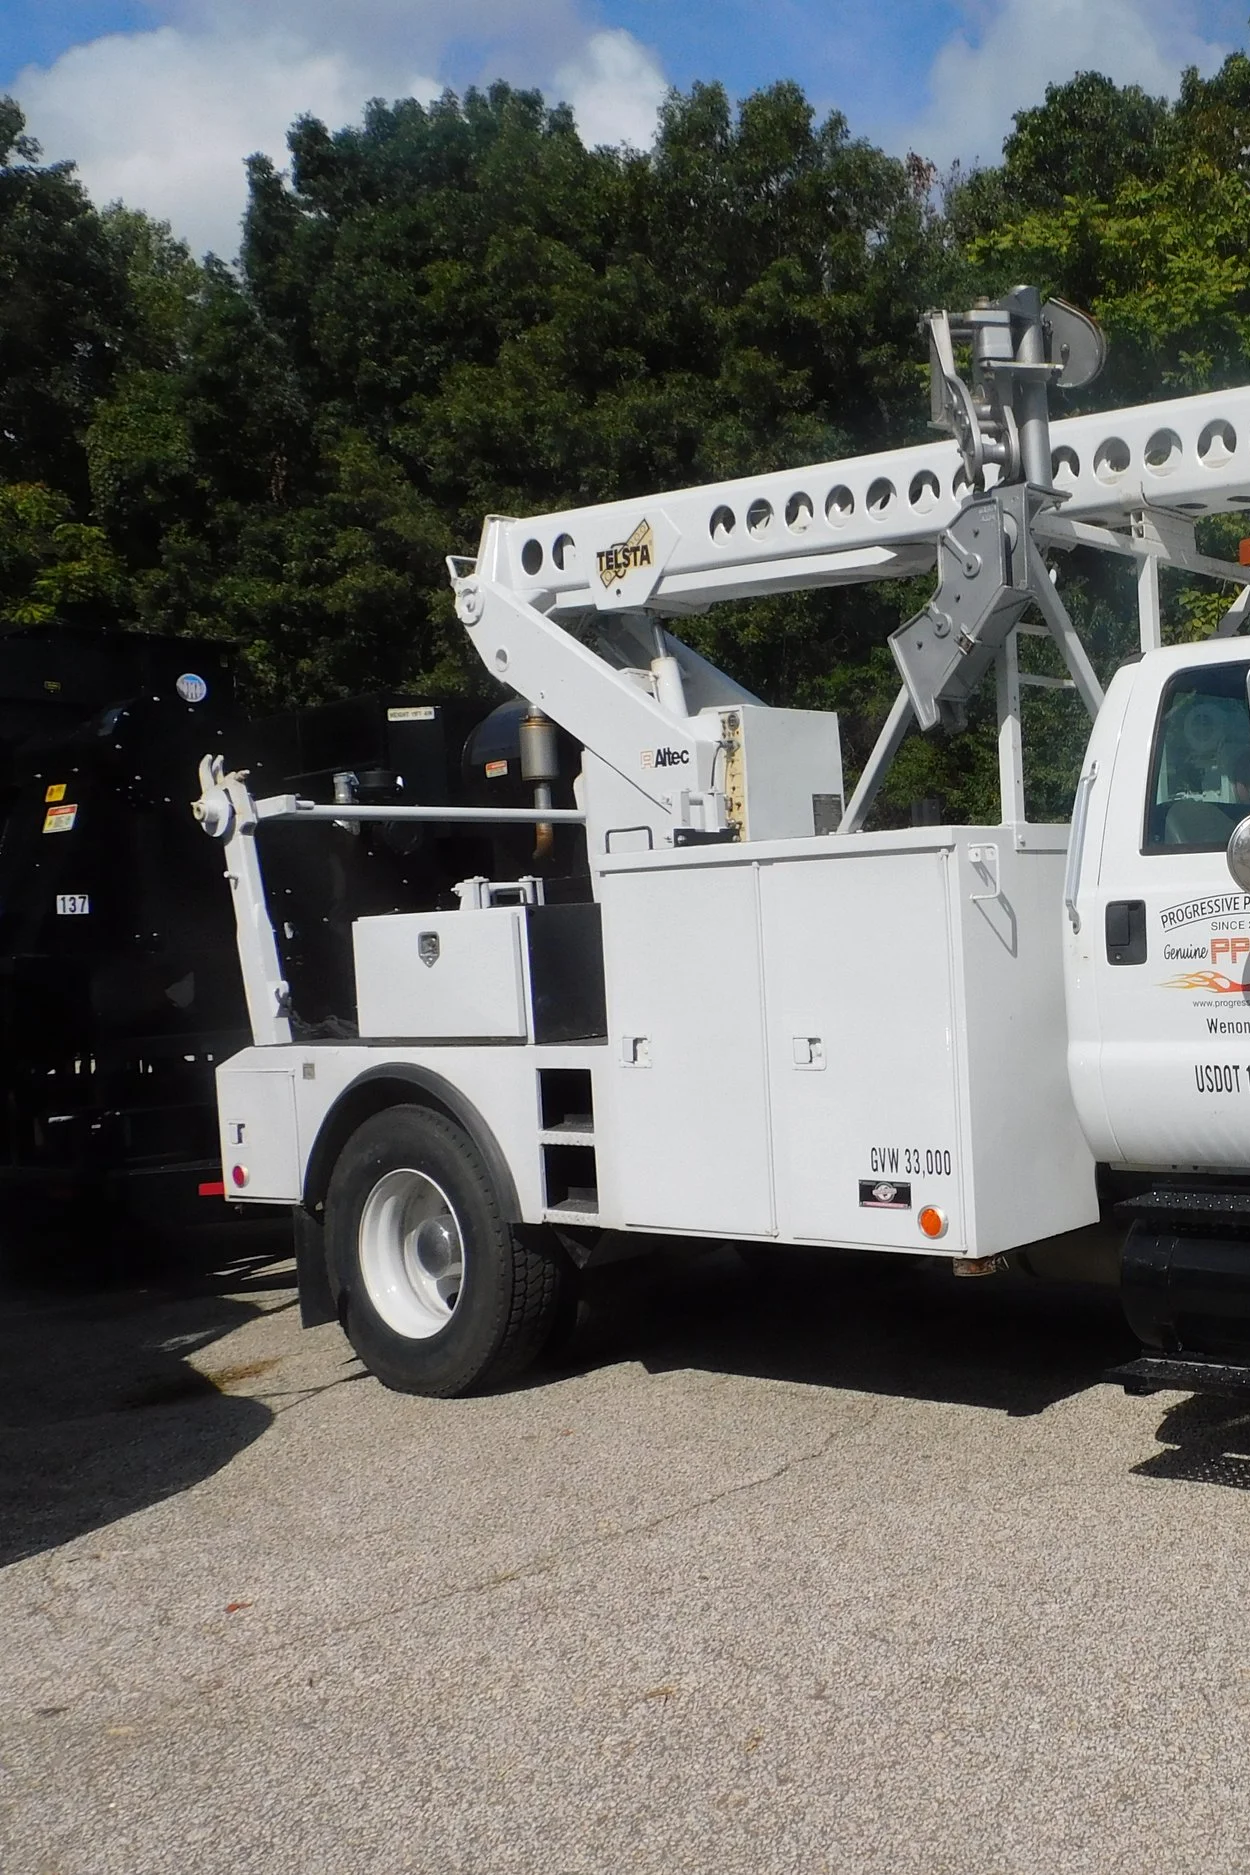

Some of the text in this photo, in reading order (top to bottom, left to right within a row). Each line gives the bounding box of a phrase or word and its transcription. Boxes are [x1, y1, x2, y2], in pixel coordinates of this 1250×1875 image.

[596, 544, 651, 571] TELSTA
[655, 747, 690, 768] Altec
[60, 895, 87, 913] 137
[1161, 896, 1240, 928] PROGRESSIVE
[1210, 920, 1245, 931] SINCE
[1163, 944, 1209, 960] Genuine
[1194, 1065, 1240, 1093] USDOT
[870, 1147, 951, 1179] GVW 33,000
